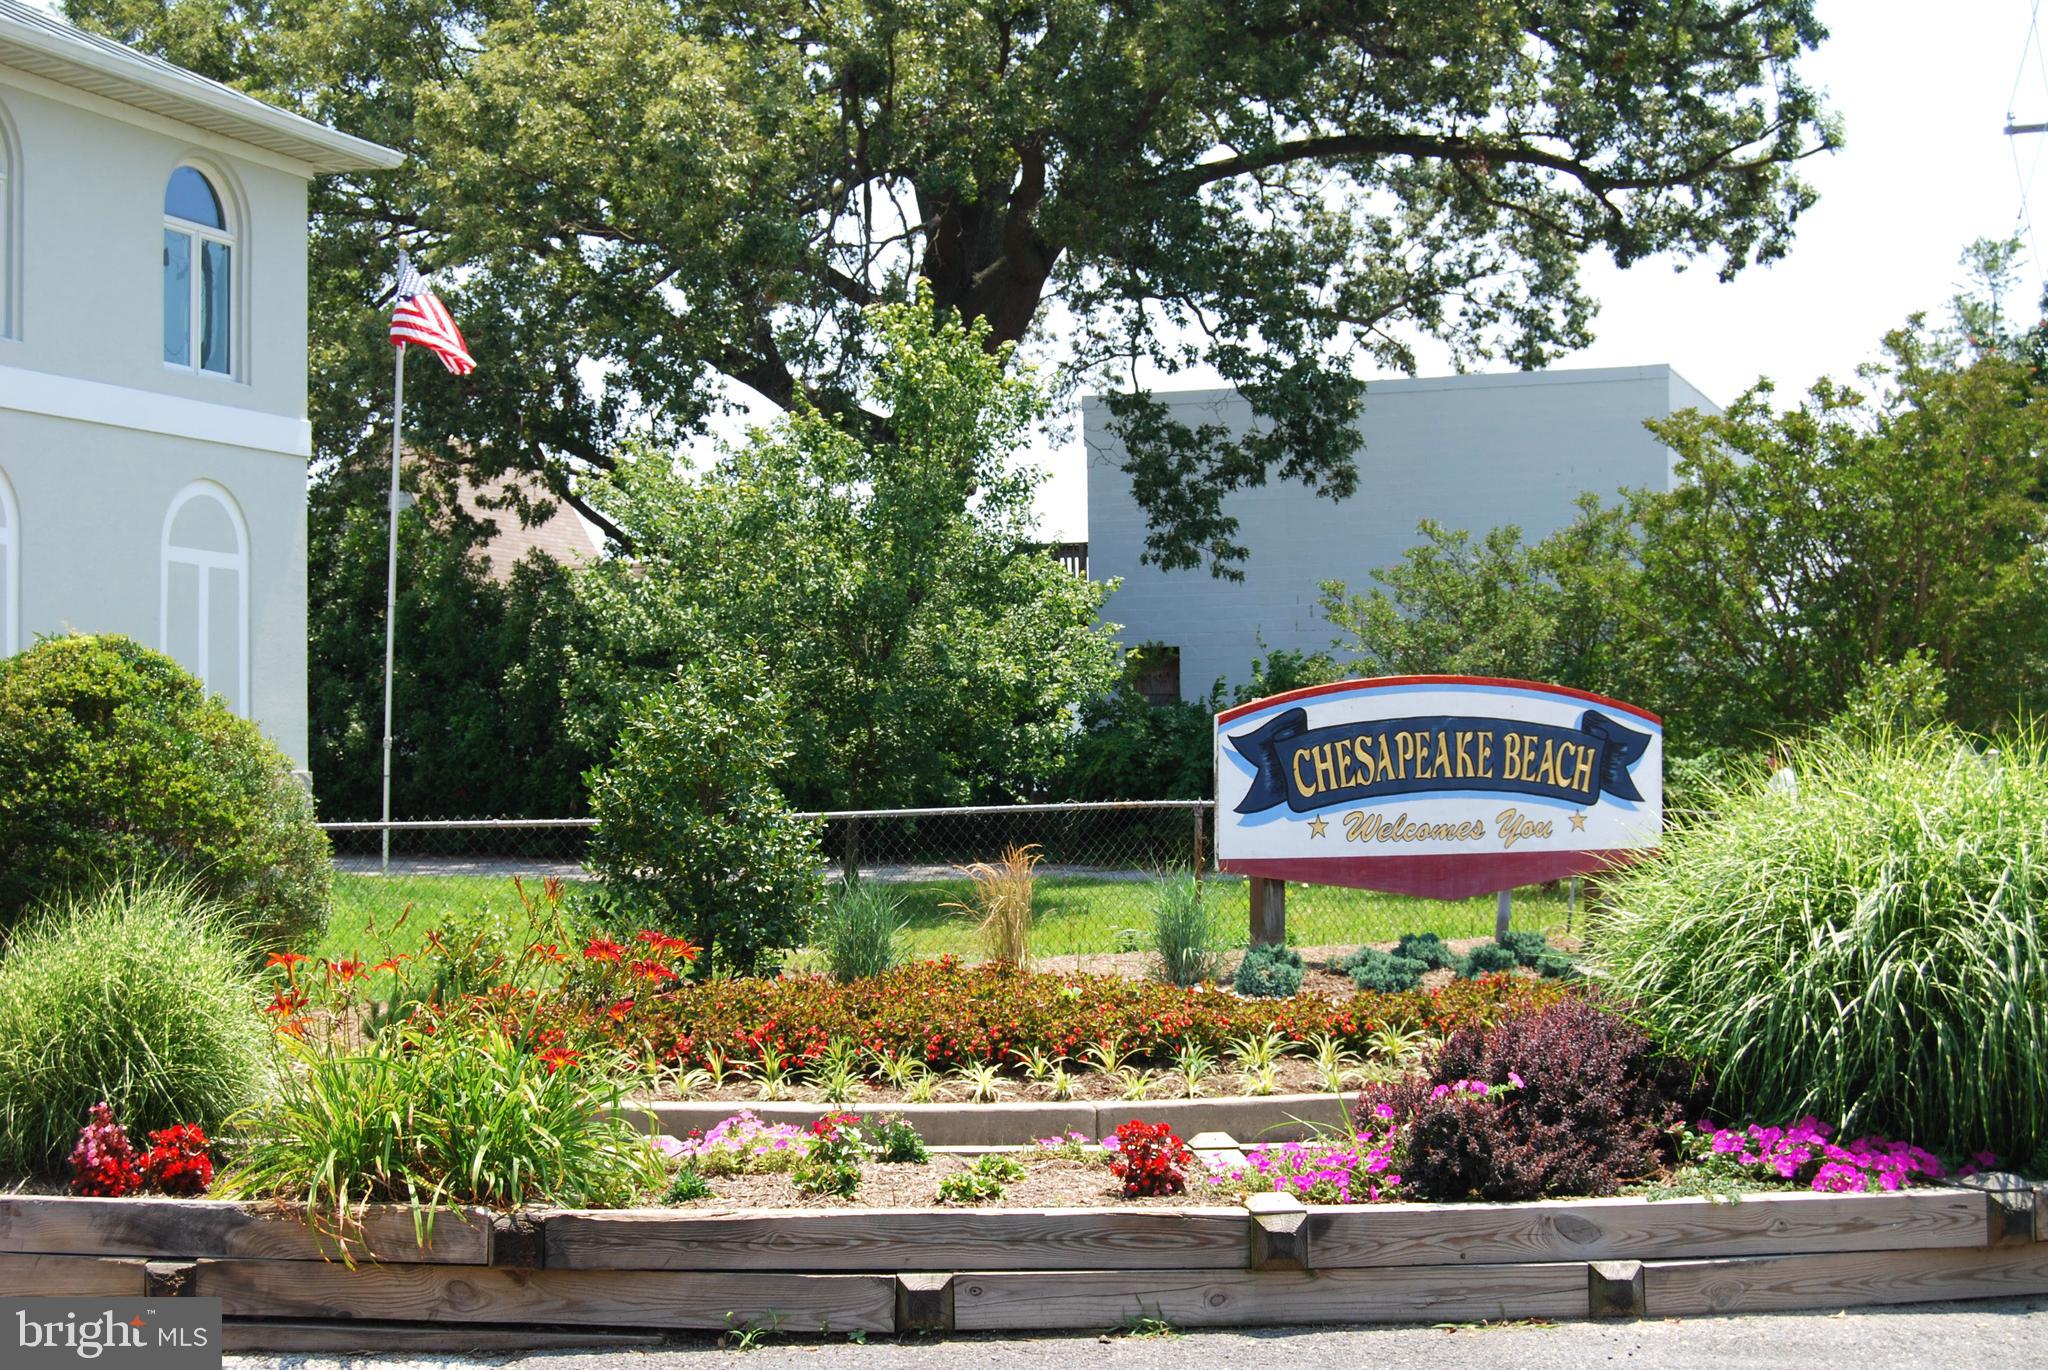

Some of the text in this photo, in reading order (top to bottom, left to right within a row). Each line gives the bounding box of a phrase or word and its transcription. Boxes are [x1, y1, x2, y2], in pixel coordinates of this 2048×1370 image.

[1293, 731, 1596, 797] CHESAPEAKE BEACH
[1343, 808, 1553, 849] Welcomes You
